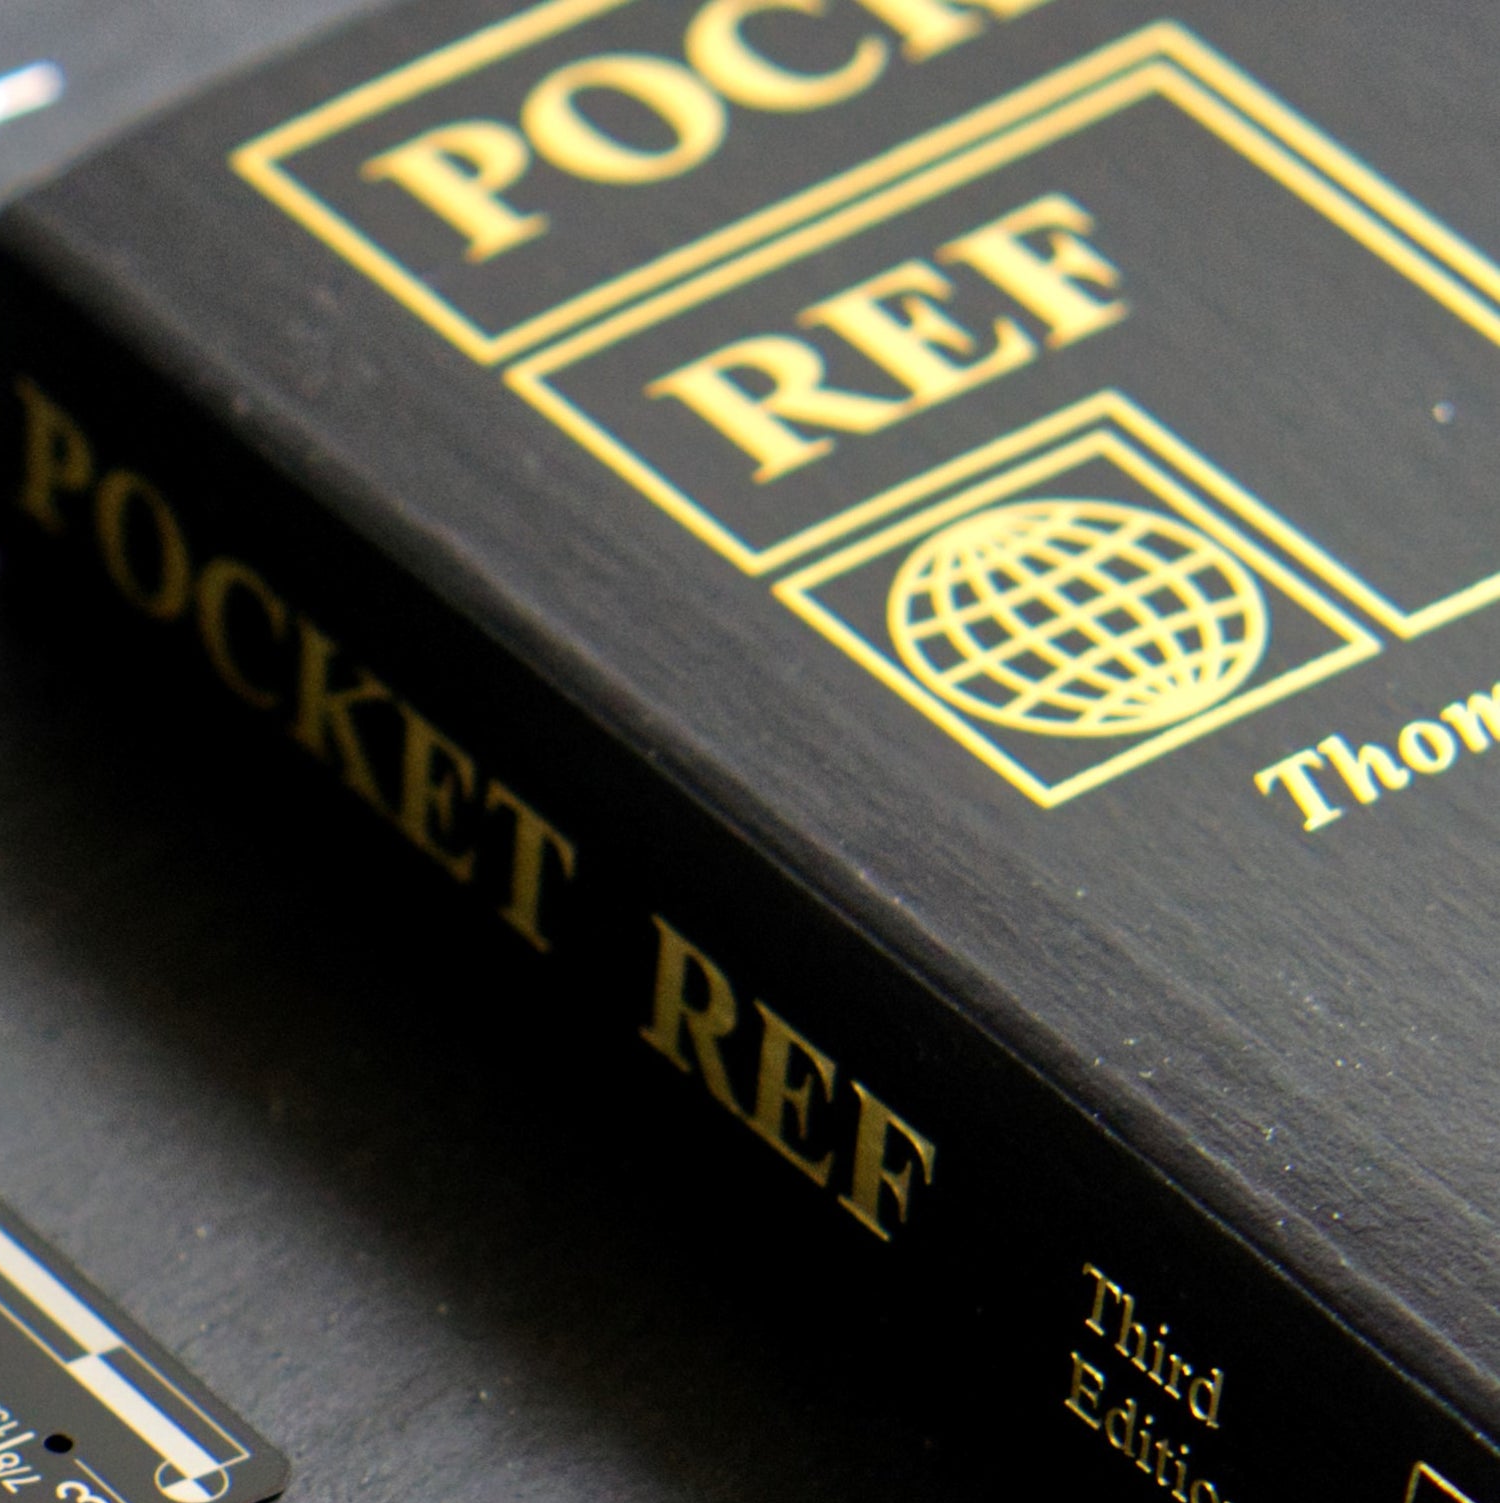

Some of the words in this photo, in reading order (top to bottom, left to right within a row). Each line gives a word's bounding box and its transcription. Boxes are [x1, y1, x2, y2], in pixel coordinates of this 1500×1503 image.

[646, 192, 1130, 486] REF
[14, 376, 578, 954] POCKET
[638, 914, 937, 1243] REF
[1083, 1262, 1225, 1429] Third
